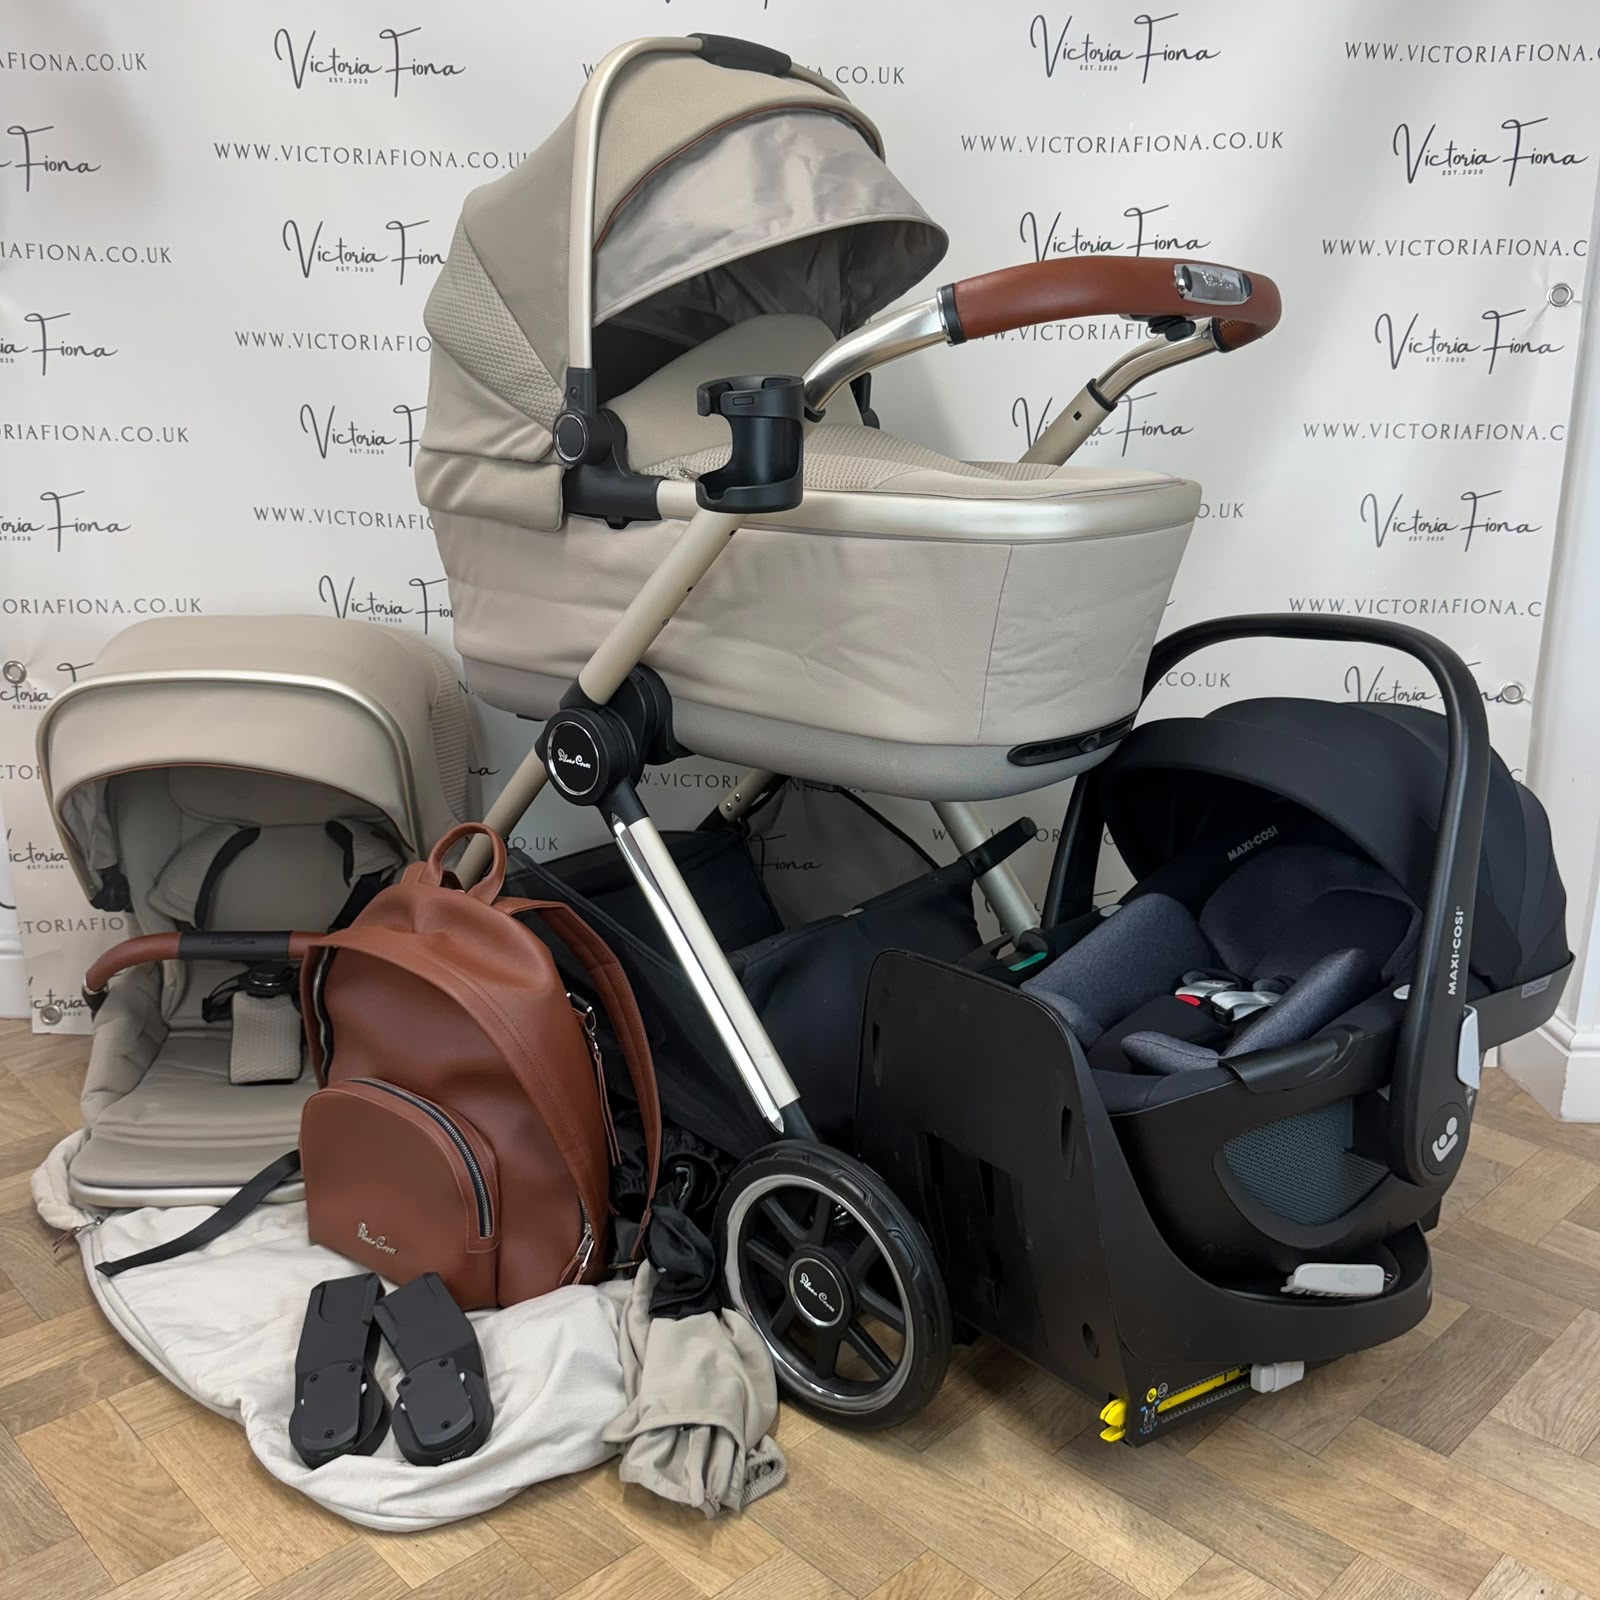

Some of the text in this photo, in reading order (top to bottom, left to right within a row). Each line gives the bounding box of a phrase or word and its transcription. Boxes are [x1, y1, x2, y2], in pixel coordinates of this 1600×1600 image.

[274, 26, 466, 98] Victoria Fiona
[1029, 12, 1221, 84] Victoria Fiona
[1345, 41, 1600, 64] WWW.VICTORIAFIONA.
[7, 125, 102, 192] Fiona
[213, 142, 527, 169] WWW.VICTORIAFIONA.CO.U
[960, 131, 1285, 154] WWW.VICTORIAFIONA.CO.UK
[1392, 117, 1588, 187] Victoria Fiona
[282, 219, 447, 286] Victoria Fion
[1019, 204, 1211, 262] Victoria Fiona
[24, 312, 119, 376] Fiona
[1375, 308, 1565, 375] Victoria Fiona
[0, 423, 190, 444] RIAFIONA.CO.UK
[300, 403, 397, 460] Victoria
[1115, 391, 1195, 458] Fiona
[40, 490, 132, 552] Fiona
[1360, 489, 1543, 552] Victoria Fiona
[318, 574, 414, 619] Victoria
[1344, 665, 1438, 704] Victoria
